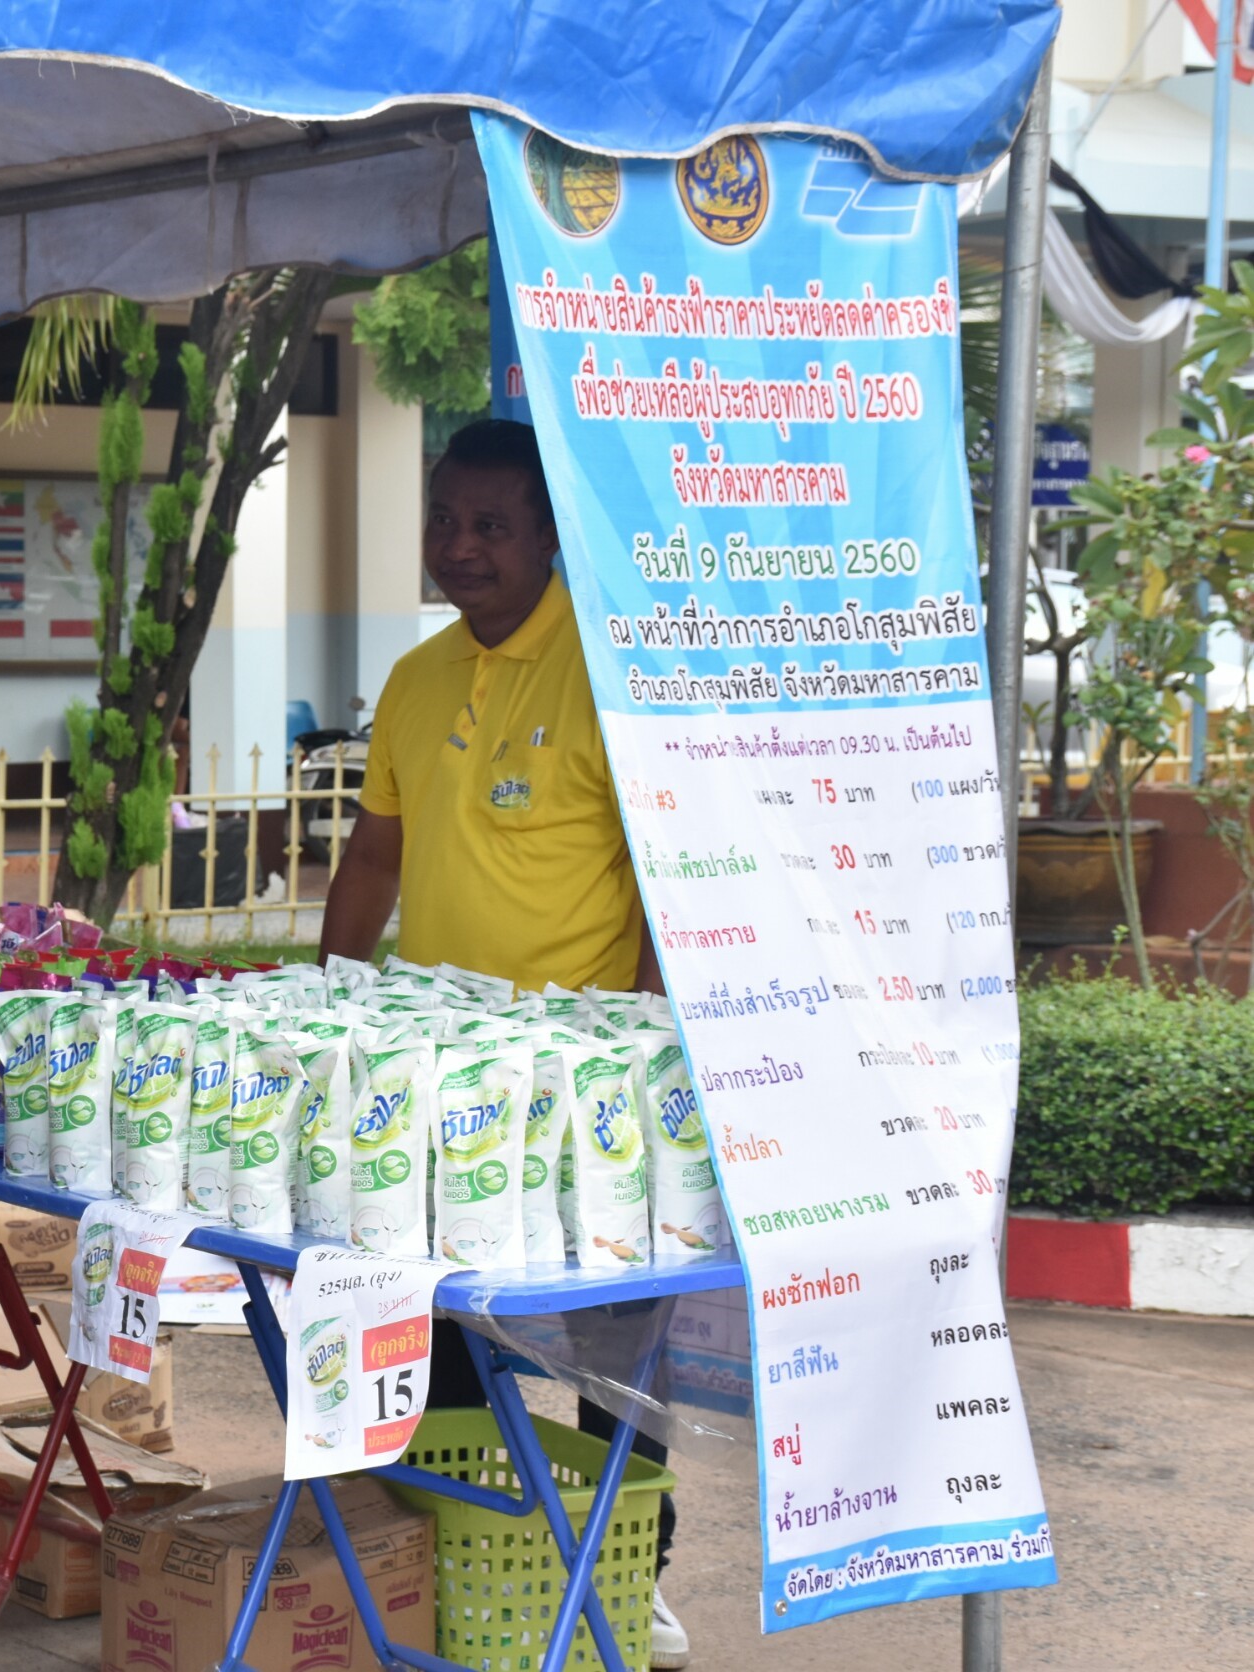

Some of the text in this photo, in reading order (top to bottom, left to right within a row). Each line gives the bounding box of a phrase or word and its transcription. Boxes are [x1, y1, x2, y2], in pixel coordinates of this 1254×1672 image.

[518, 271, 953, 337] การจำหน่ายสินค้าธงฟ้าราคาประหยัดลดค่าครองชี
[575, 346, 835, 438] เพื่อช่วยเหลือผู้ประสบอุทกภัย
[837, 365, 856, 418] ปี
[863, 376, 918, 418] 2560
[673, 448, 846, 502] จังหวัดมหาสารคาม
[636, 528, 916, 578] วันที่ 9 กันยายน 2560
[610, 596, 976, 653] ณ หน้าที่ว่าการอำเภอโกสุมพิสัย
[629, 662, 979, 711] อำเภอโกสุมพิสัย จังหวัดมหาสารคาม
[839, 735, 880, 755] 09.30
[885, 738, 900, 754] น.
[903, 723, 972, 752] เป็นต้นไป
[655, 788, 676, 811] #3
[811, 778, 837, 805] 75
[845, 785, 875, 804] บาท
[911, 778, 944, 804] (100
[830, 844, 857, 871] 30
[863, 851, 892, 869] บาท
[926, 844, 959, 869] (300
[661, 911, 757, 949] น้ำตาลทราย
[854, 909, 877, 936] 15
[883, 917, 910, 934] บาท
[946, 911, 976, 934] (120
[681, 976, 829, 1020] บะหมี่กึ่งสำเร็จรูป
[878, 976, 914, 1002] 2.50
[916, 982, 945, 1001] บาท
[960, 976, 1002, 1002] (2,000
[4, 1033, 45, 1075] ซันไล
[702, 1055, 803, 1092] ปลากระป๋อง
[913, 1042, 935, 1067] 10
[935, 1047, 961, 1066] บาท
[660, 1088, 697, 1141] ซันไล
[933, 1106, 958, 1131] 20
[959, 1111, 986, 1130] บาท
[721, 1124, 783, 1164] น้ำปลา
[906, 1181, 960, 1206] ขวดละ
[966, 1168, 993, 1196] 30
[743, 1192, 890, 1236] ซอสหอยนางรม
[318, 1270, 402, 1298] 525มล. (ถุง)
[762, 1267, 861, 1309] ผงซักฟอก
[929, 1253, 970, 1284] ถุงละ
[118, 1294, 147, 1339] 15
[930, 1321, 1009, 1347] หลอดละ
[371, 1325, 429, 1367] (ถูกจริง)
[768, 1344, 839, 1384] ยาสีฟัน
[372, 1369, 413, 1422] 15
[936, 1396, 1011, 1421] แพคละ
[772, 1423, 802, 1466] สบู่
[775, 1483, 898, 1533] น้ำยาล้างจาน
[946, 1473, 1002, 1504] ถุงละ
[106, 1526, 141, 1548] 277689
[788, 1567, 834, 1598] จัดโดย
[847, 1542, 1005, 1583] จังหวัดมหาสารคาม
[1013, 1528, 1052, 1559] ร่วมกั
[293, 1626, 348, 1654] Magiclean
